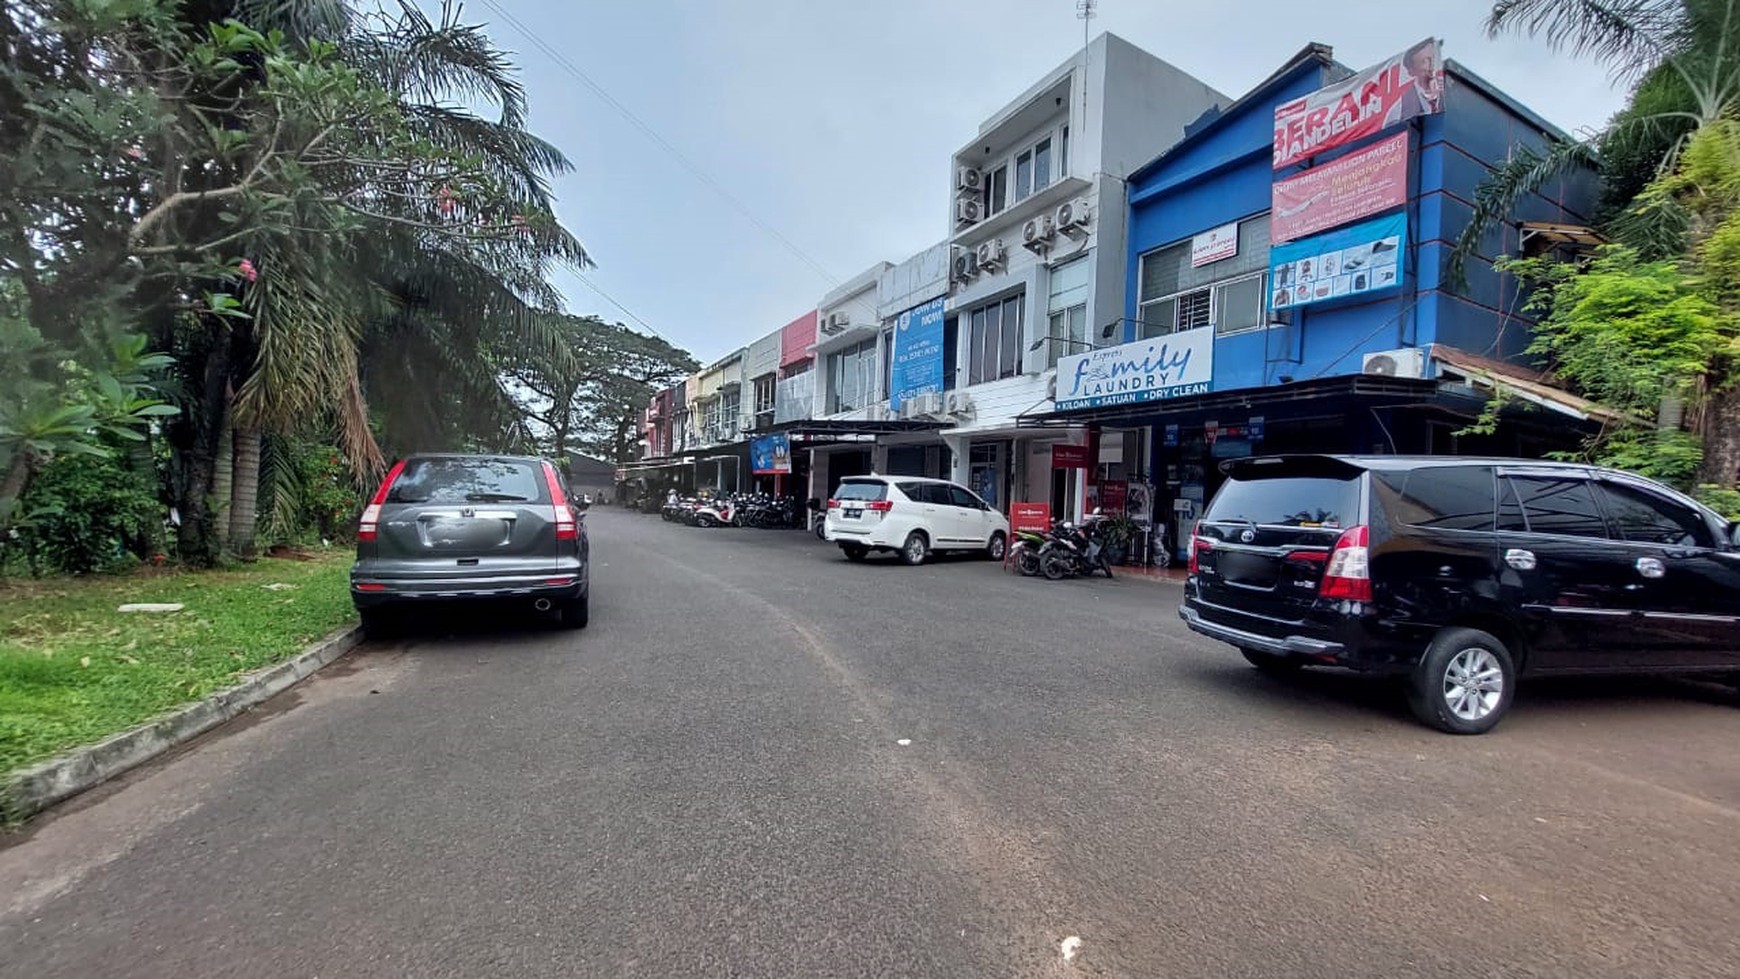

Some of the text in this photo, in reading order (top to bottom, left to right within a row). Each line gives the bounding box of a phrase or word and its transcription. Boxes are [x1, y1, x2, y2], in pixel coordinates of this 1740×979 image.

[1092, 349, 1123, 362] Express
[1084, 372, 1170, 396] LAUNDRY
[1062, 383, 1208, 410] KILOAN SATUAN DRY CLEAN
